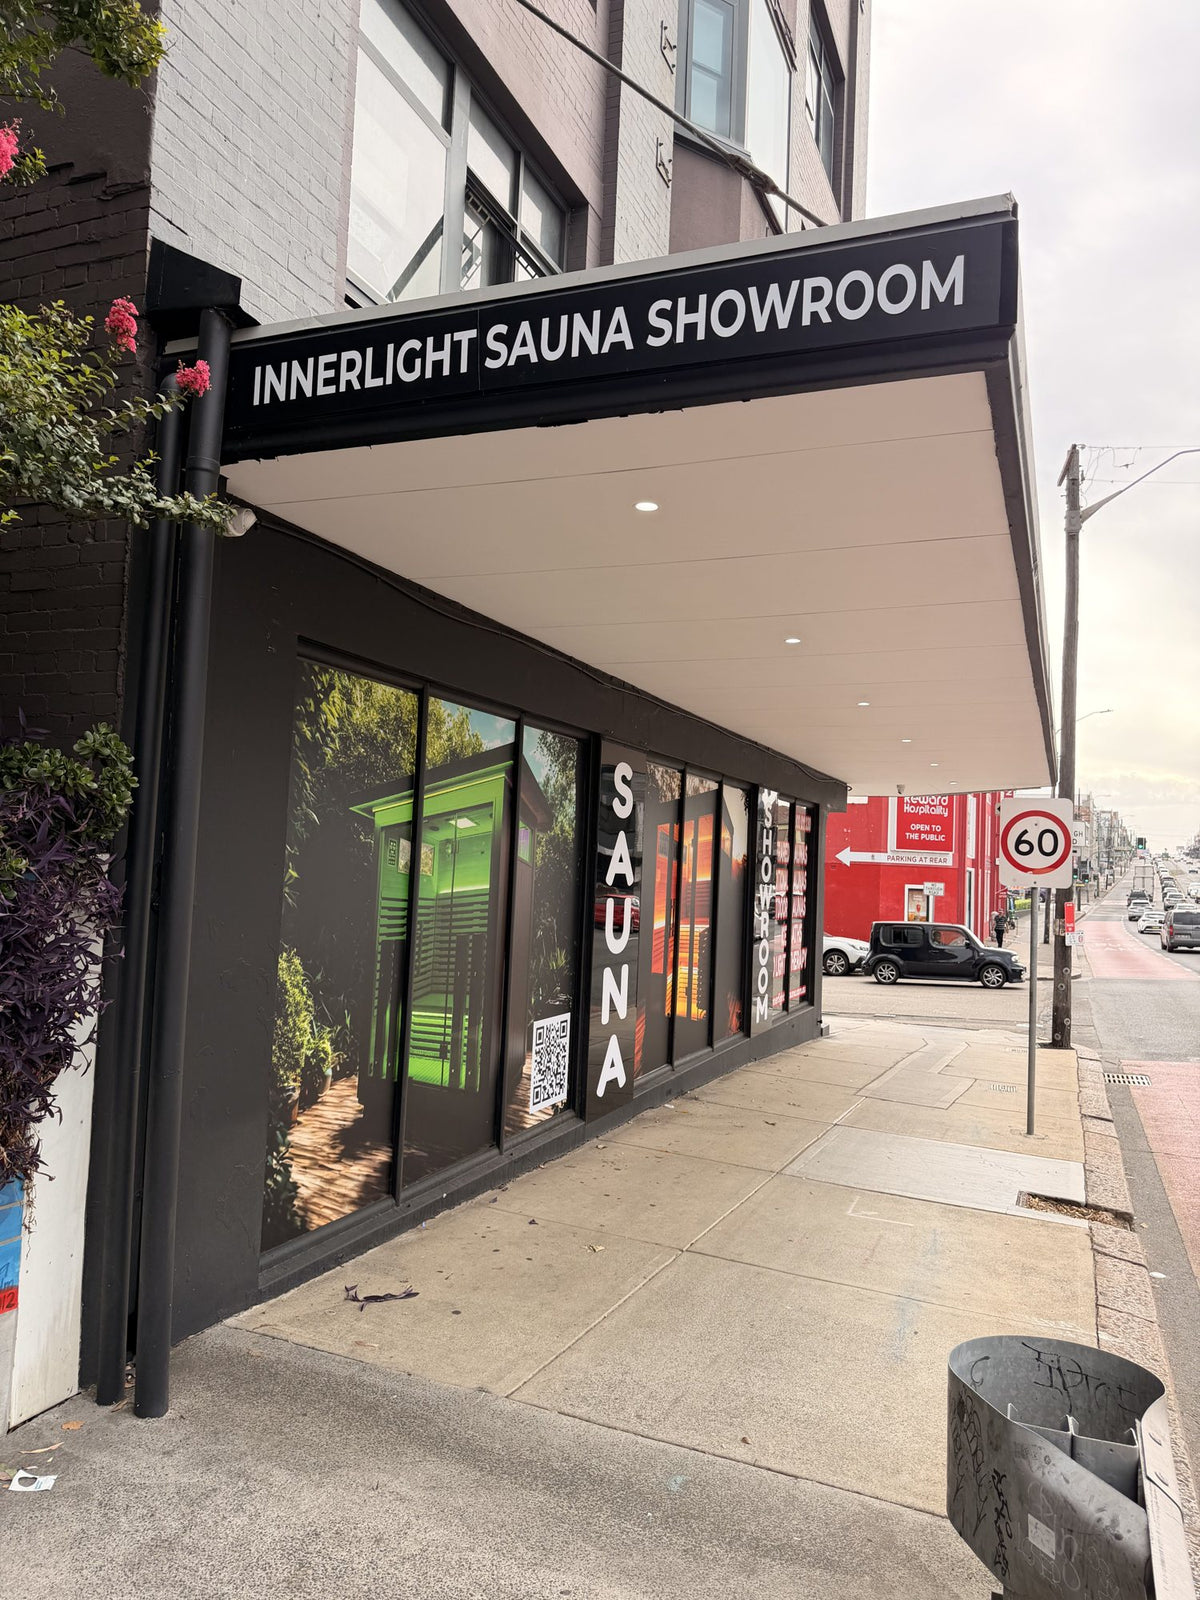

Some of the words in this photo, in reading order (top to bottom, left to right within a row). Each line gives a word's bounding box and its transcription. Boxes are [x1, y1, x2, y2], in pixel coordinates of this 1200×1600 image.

[252, 328, 478, 406] INNERLIGHT
[484, 307, 634, 369] SAUNA
[646, 254, 965, 346] SHOWROOM
[904, 804, 948, 817] Hospitality
[905, 832, 919, 840] THE
[920, 833, 946, 841] PUBLIC
[910, 823, 930, 831] OPEN
[1014, 828, 1059, 857] 60
[886, 854, 917, 862] PARKING
[756, 806, 774, 1024] SHOWROOM
[597, 762, 633, 1098] SAUNA
